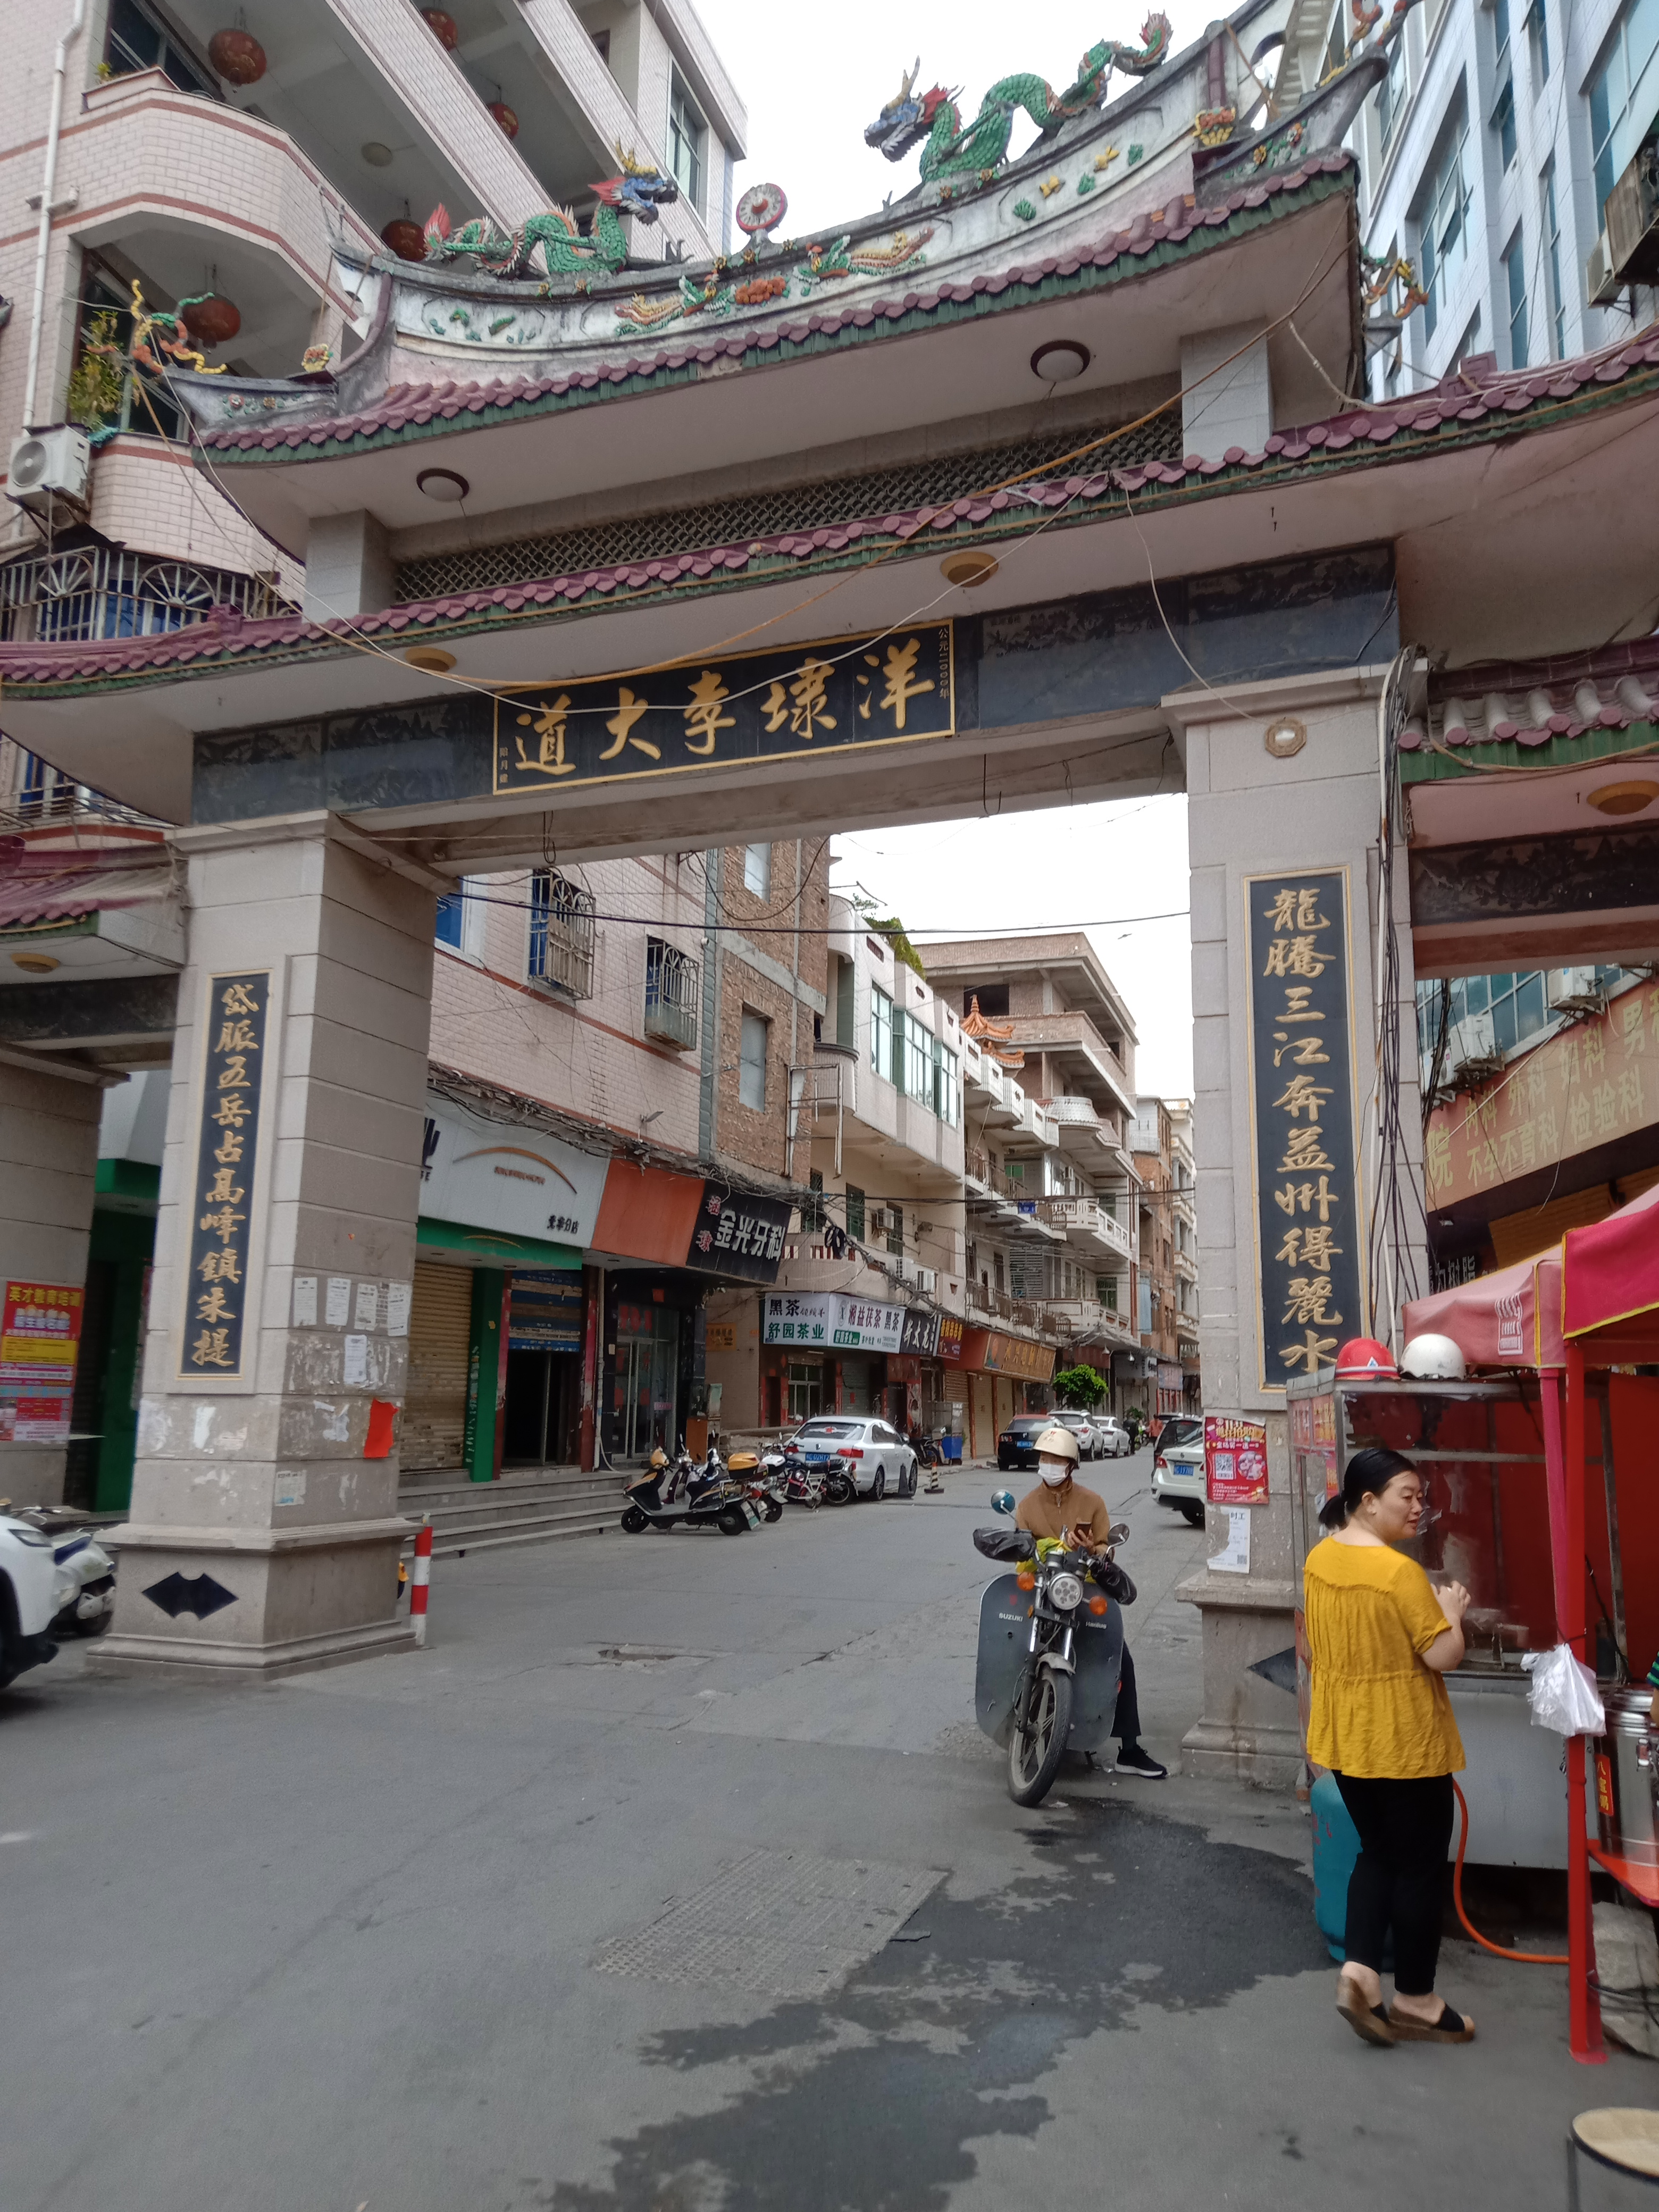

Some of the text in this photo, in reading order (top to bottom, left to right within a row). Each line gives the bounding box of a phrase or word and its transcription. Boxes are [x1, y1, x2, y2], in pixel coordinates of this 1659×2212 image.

[1465, 1085, 1497, 1140] 内科
[1509, 1060, 1547, 1117] 外科
[1559, 1021, 1606, 1092] 妇科
[1466, 1066, 1645, 1187] 不孕不育科 检验科
[714, 1210, 786, 1262] 金光牙科
[769, 1299, 800, 1317] 黑茶
[848, 1304, 900, 1331] 湘益茯茶 黑茶
[768, 1322, 824, 1339] 舒园茶业
[999, 1612, 1023, 1622] SUZUKI
